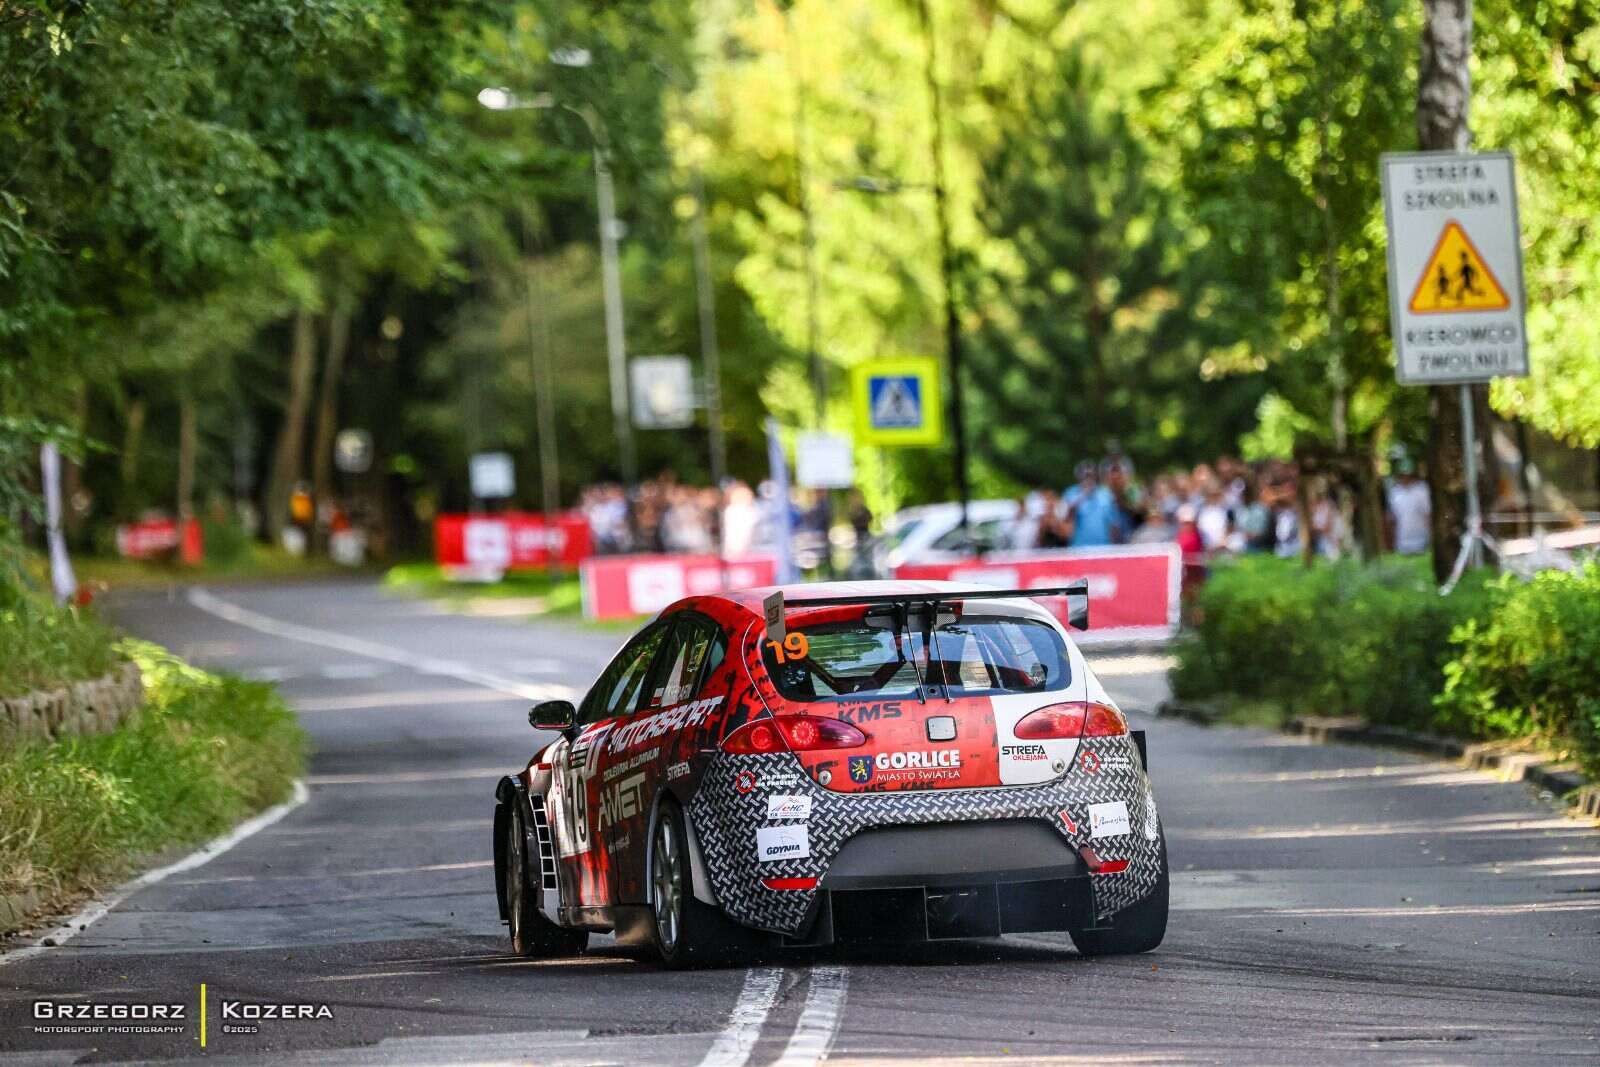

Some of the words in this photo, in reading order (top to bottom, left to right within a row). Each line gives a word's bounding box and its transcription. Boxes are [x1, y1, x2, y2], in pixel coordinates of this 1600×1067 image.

[1415, 164, 1486, 183] STREFA
[1404, 188, 1500, 210] SZKOLNA
[766, 632, 809, 664] 19
[838, 702, 902, 725] KMS
[875, 750, 961, 769] GORLICE
[1002, 745, 1046, 756] STREFA
[876, 771, 916, 782] MIASTO
[918, 769, 961, 780] ŚWIATŁA
[598, 771, 647, 832] AMET
[766, 844, 801, 856] GDYNIA
